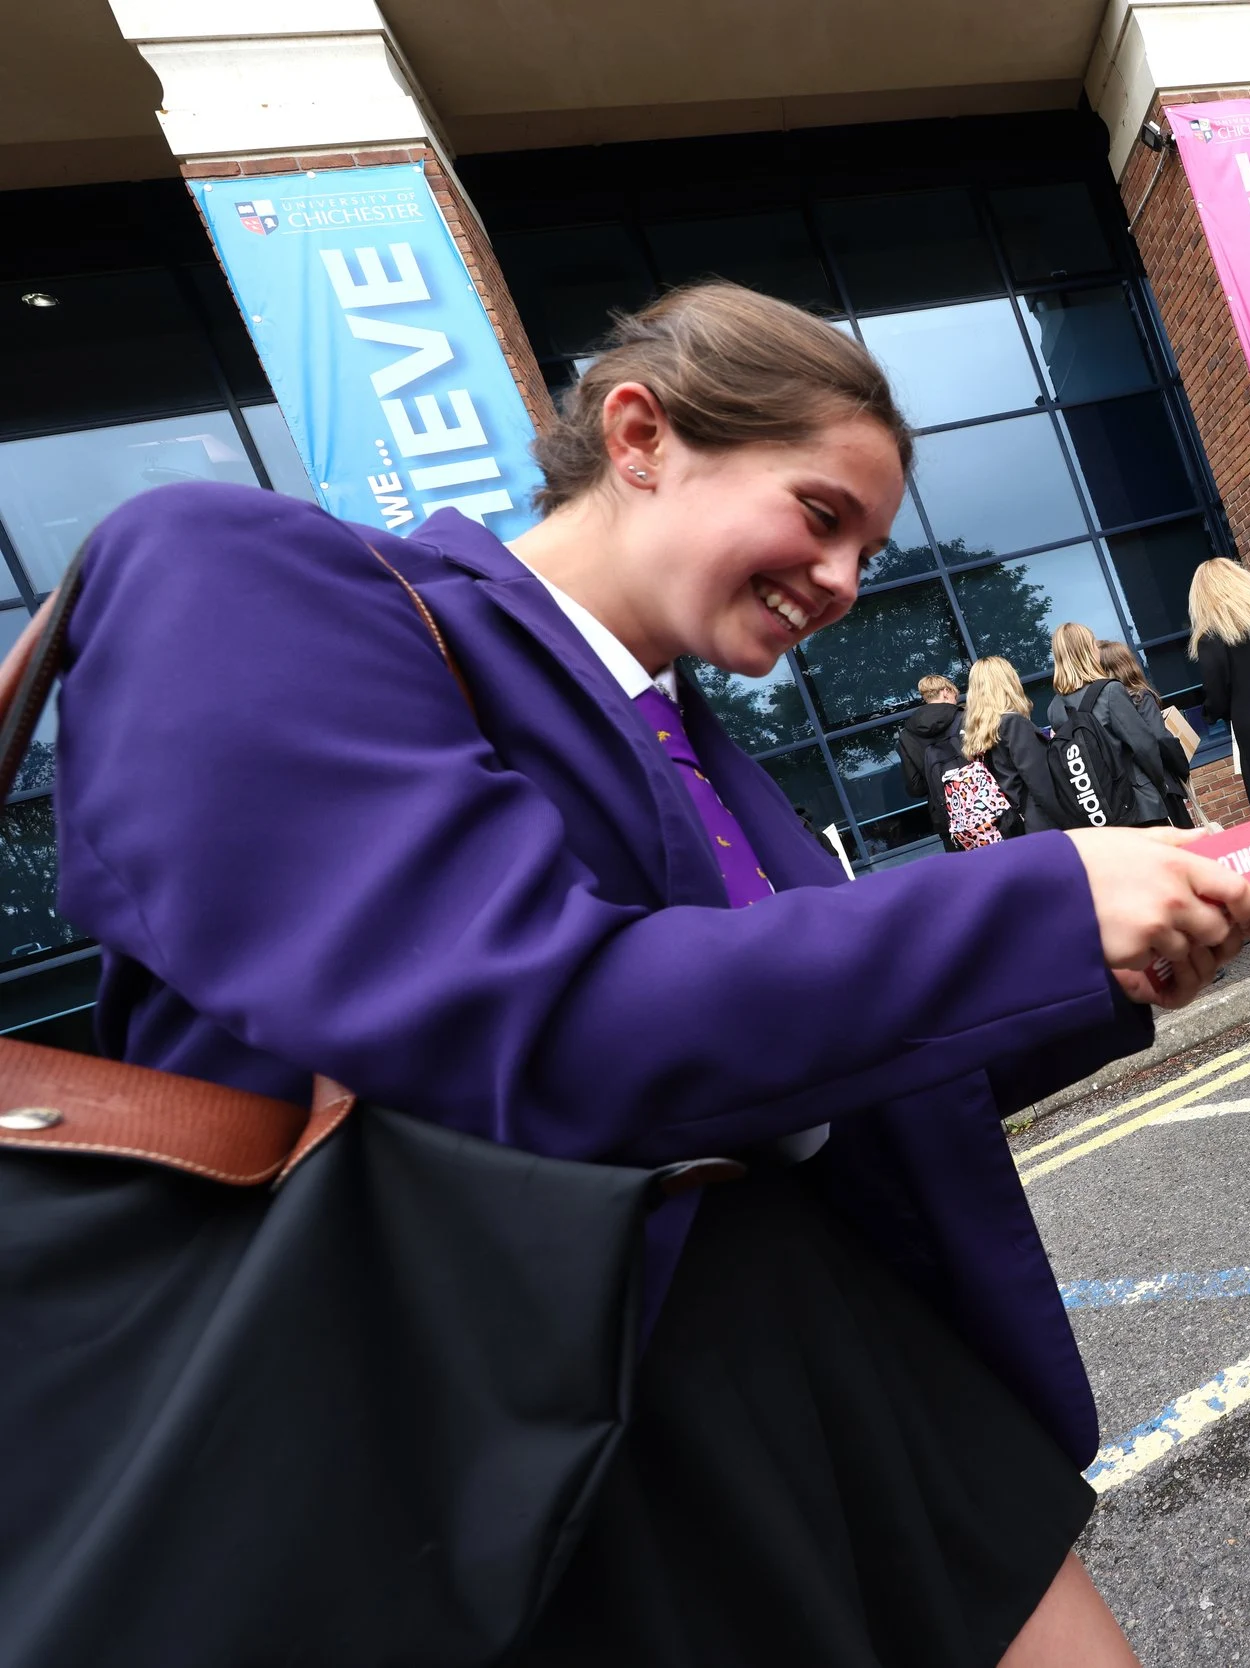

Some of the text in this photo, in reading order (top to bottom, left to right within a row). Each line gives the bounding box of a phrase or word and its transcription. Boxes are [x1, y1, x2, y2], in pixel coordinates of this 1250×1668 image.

[281, 191, 415, 212] UNIVERSITY OF
[288, 202, 424, 228] CHICHESTER
[1066, 744, 1107, 827] adidas
